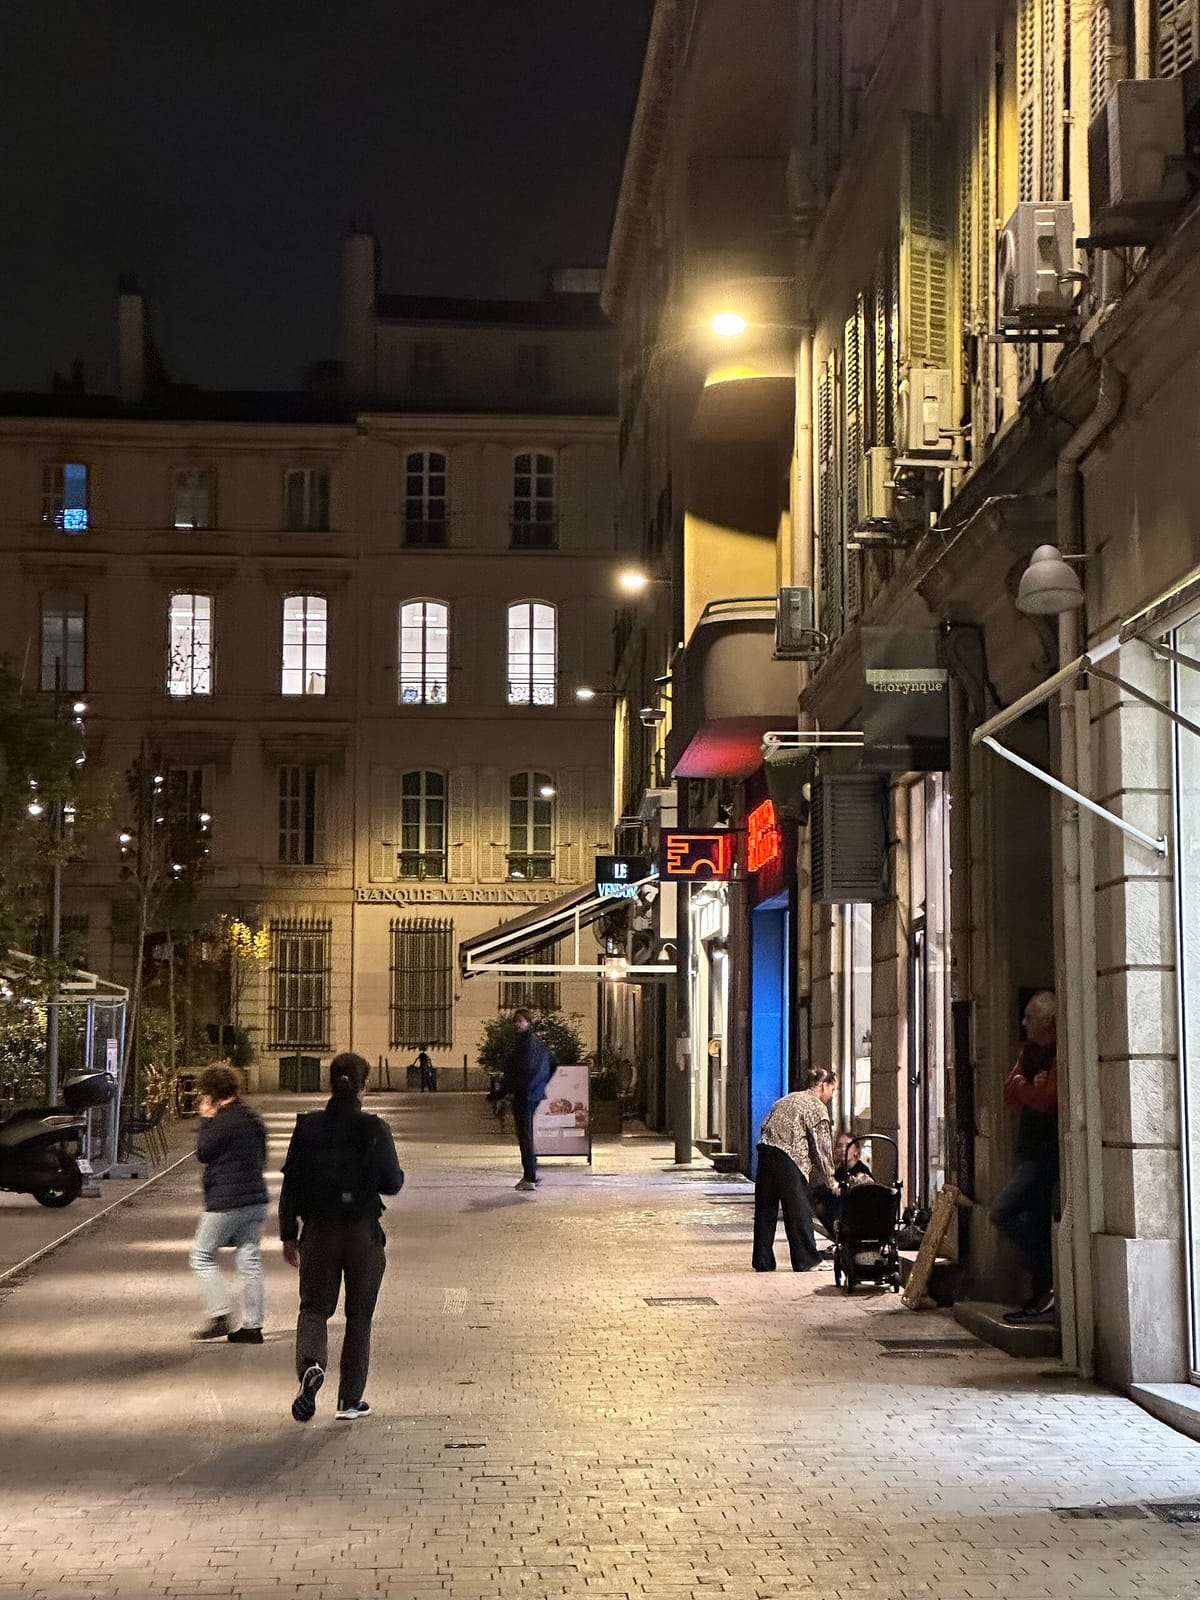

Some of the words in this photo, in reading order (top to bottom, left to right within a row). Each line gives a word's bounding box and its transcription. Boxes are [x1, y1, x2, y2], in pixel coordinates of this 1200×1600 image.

[614, 863, 627, 879] LE
[356, 888, 433, 906] BANQUE
[442, 888, 516, 903] MARTIN
